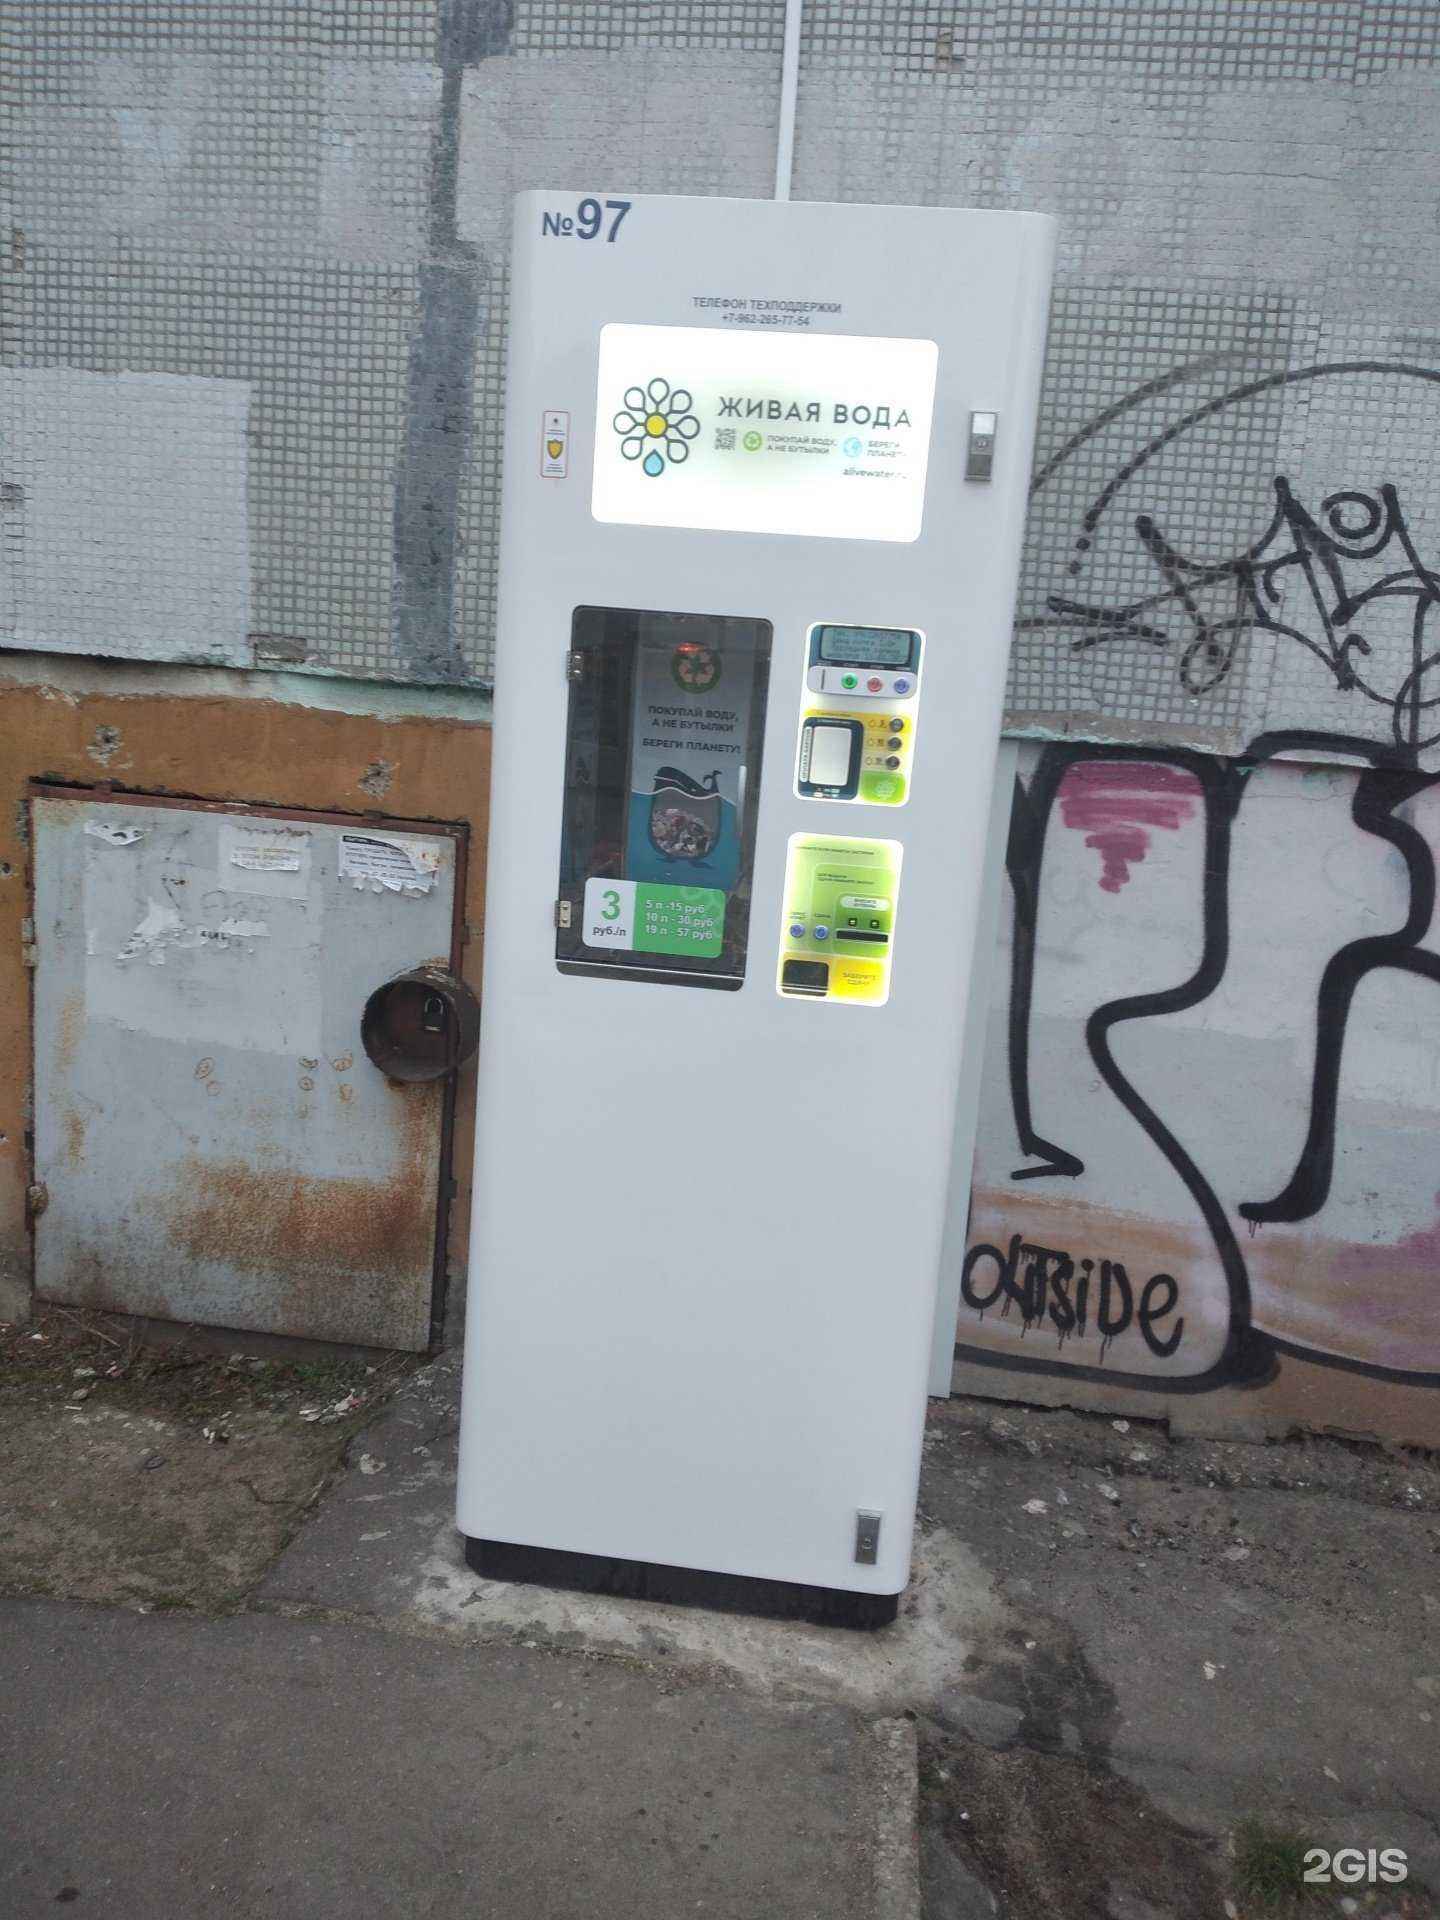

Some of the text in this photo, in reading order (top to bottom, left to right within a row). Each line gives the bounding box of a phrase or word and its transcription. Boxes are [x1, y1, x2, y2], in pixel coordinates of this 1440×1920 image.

[692, 297, 842, 313] ТЕЛЕФОН ТЕХПОДДЕРЖКИ
[718, 396, 912, 430] ЖИВАЯ ВОДА
[648, 705, 703, 718] ПОКУПАЙ
[652, 718, 734, 732] А НЕ БУТЫЛКИ
[642, 738, 742, 754] БЕРЕГИ ПЛАНЕТУ!
[600, 890, 621, 921] 3
[645, 899, 653, 910] 5
[684, 903, 706, 915] руб
[693, 916, 714, 928] руб
[677, 927, 690, 938] 57
[692, 930, 714, 941] руб
